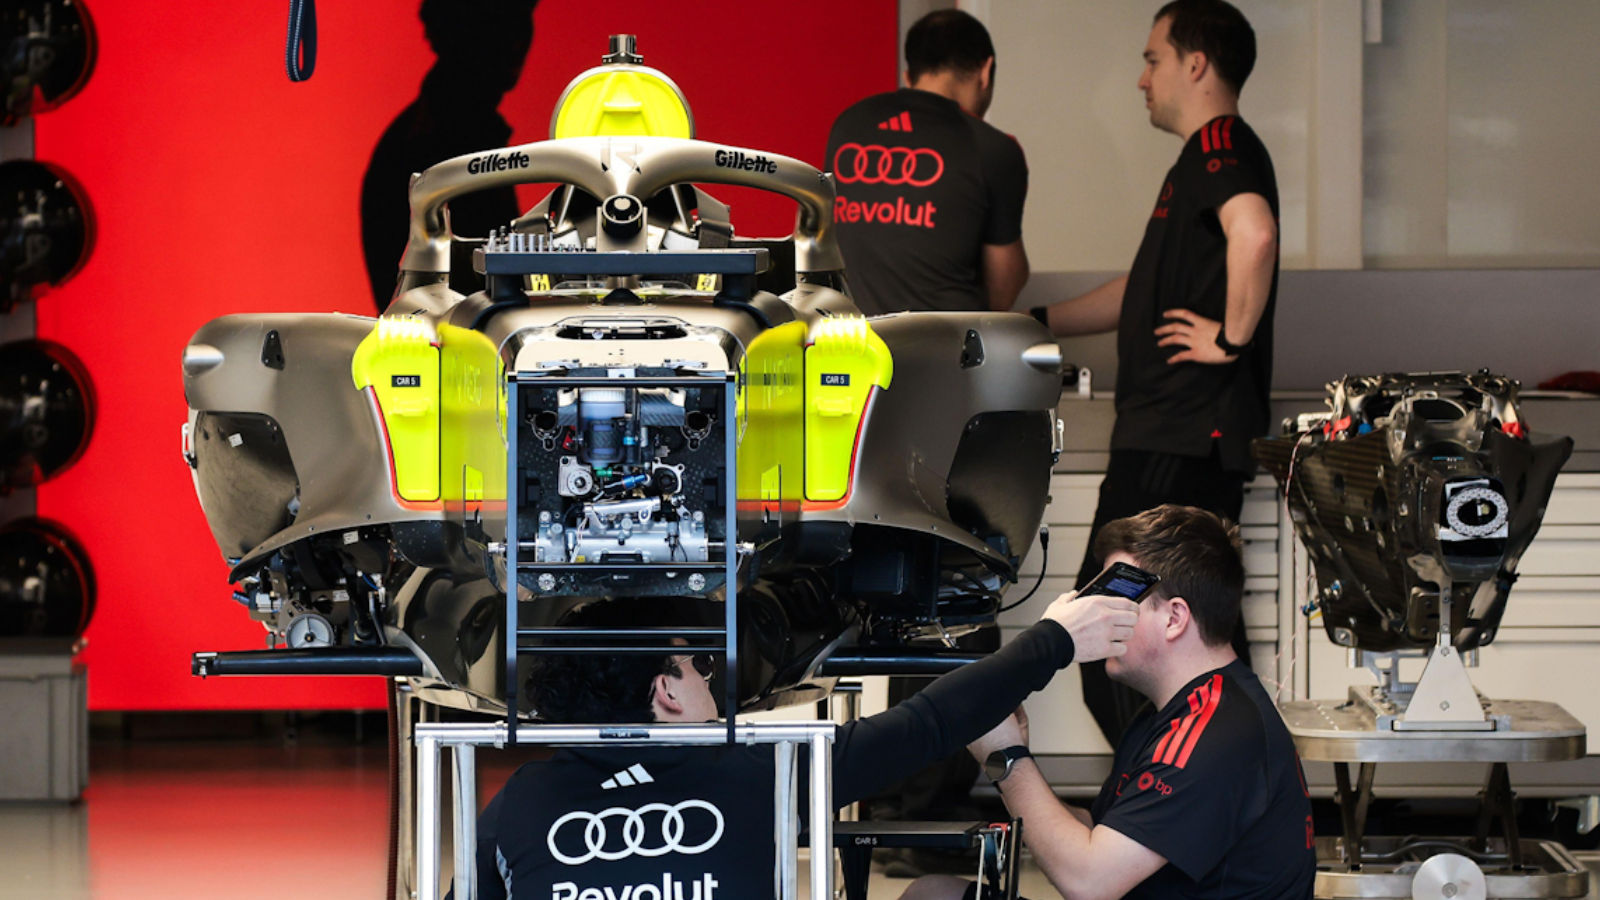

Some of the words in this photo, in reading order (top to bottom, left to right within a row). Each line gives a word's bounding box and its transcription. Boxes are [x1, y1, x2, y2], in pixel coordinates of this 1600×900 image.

[467, 151, 530, 175] Gillette
[715, 149, 778, 174] Gillette
[834, 195, 936, 228] Revolut
[1155, 778, 1172, 796] bp
